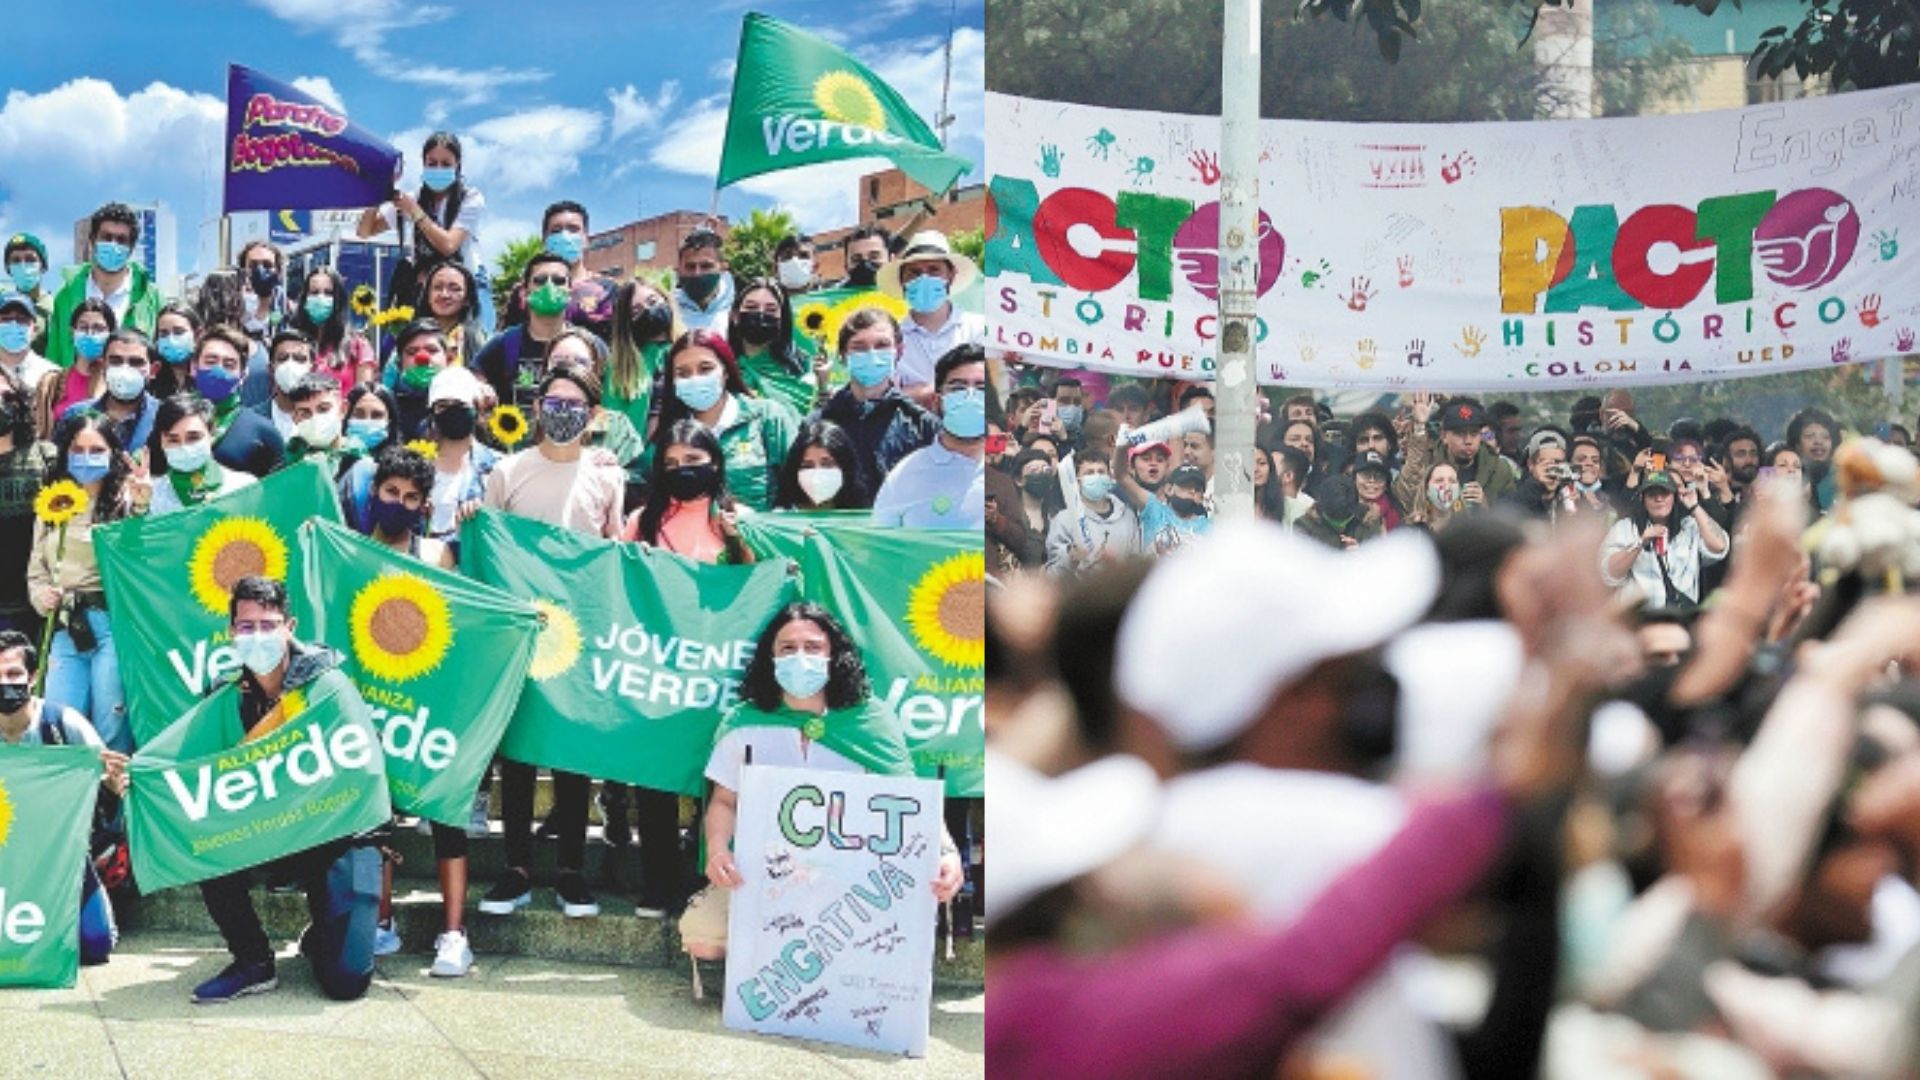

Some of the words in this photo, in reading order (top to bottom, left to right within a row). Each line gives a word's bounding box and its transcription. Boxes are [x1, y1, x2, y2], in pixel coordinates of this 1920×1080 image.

[1499, 187, 1861, 315] PACTO
[984, 325, 1115, 359] LOMBIA
[1502, 296, 1846, 347] HISTÓRICO
[163, 722, 373, 821] Verde
[217, 731, 304, 771] ALIANZA
[778, 785, 920, 856] CLJ
